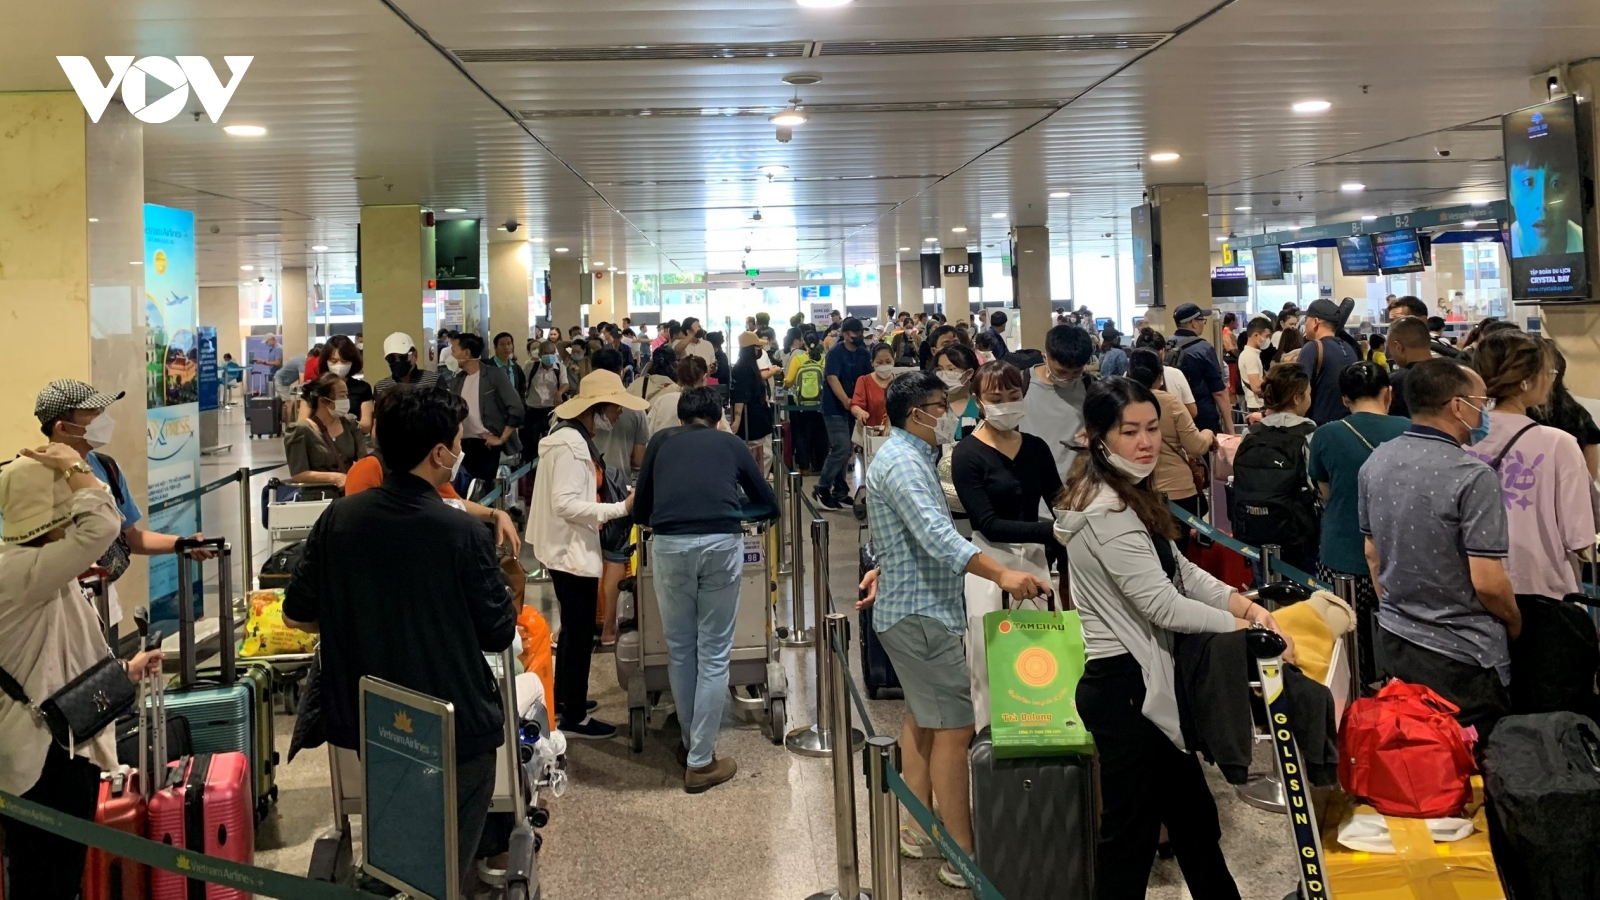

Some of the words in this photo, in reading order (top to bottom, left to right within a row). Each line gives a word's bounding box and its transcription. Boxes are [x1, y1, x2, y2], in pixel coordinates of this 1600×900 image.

[1395, 215, 1409, 228] B-2
[1352, 222, 1364, 233] B-1
[947, 265, 956, 273] 10
[958, 264, 969, 273] 23
[1530, 276, 1557, 284] CRYSTAL
[1002, 713, 1018, 722] Trà
[1274, 713, 1308, 825] GOLDSUN
[1301, 846, 1324, 900] GRO
